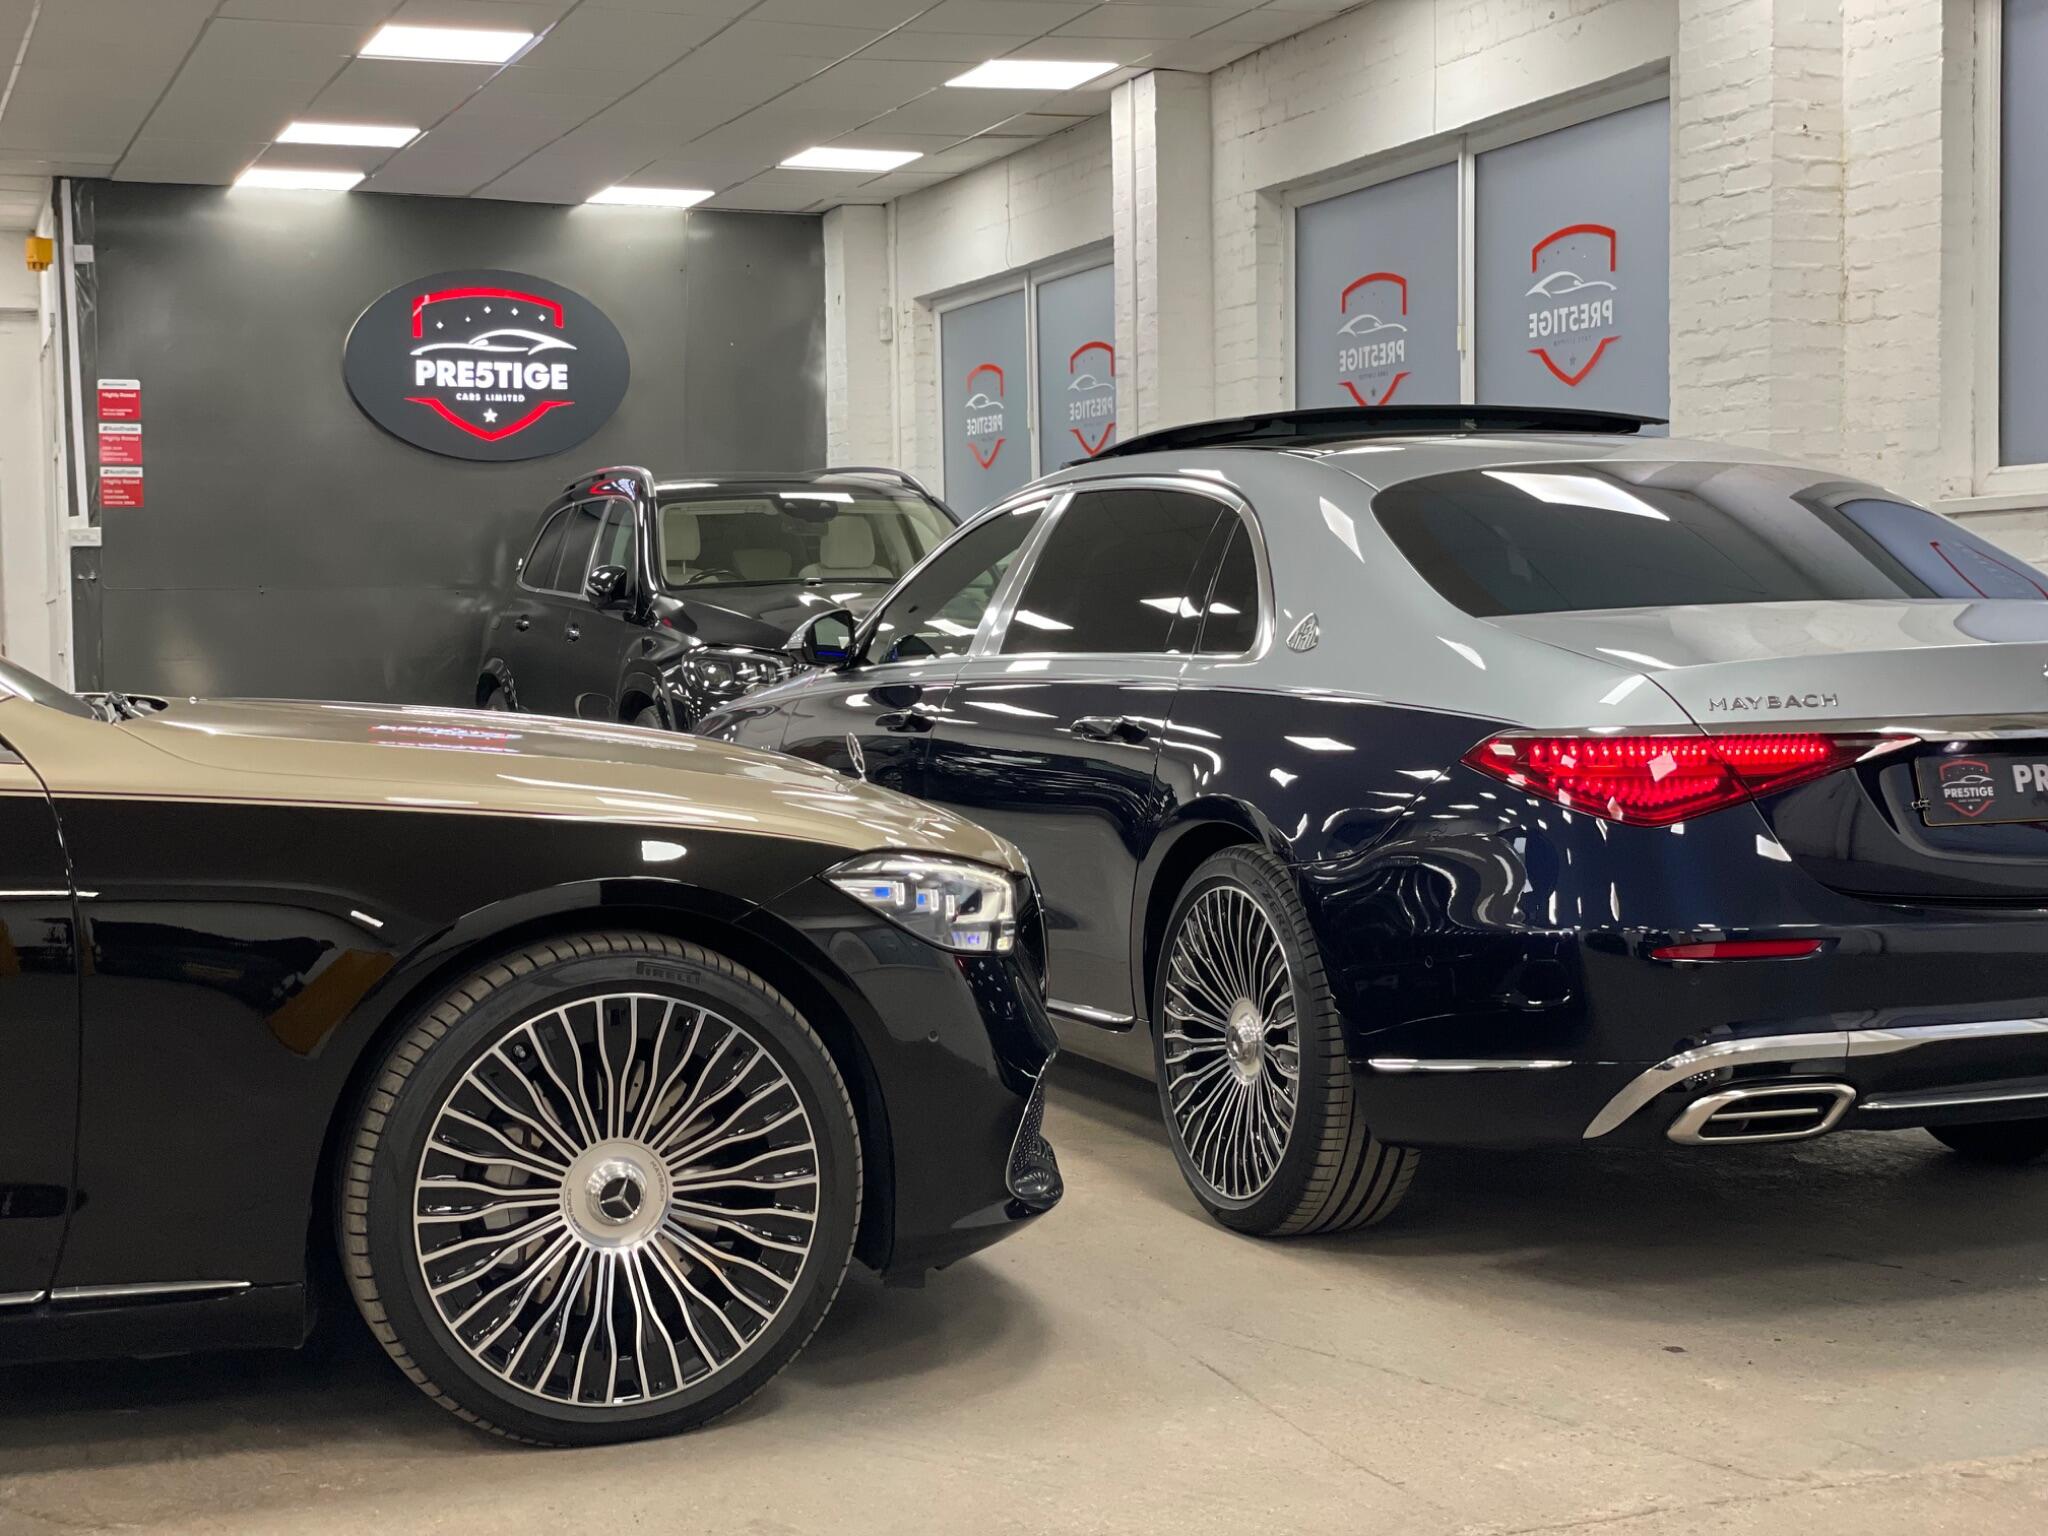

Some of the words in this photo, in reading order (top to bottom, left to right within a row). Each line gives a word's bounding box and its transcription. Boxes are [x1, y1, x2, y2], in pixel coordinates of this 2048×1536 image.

[455, 392, 481, 402] CARS
[485, 393, 526, 402] LIMITED
[1708, 693, 1839, 712] MAYBACH
